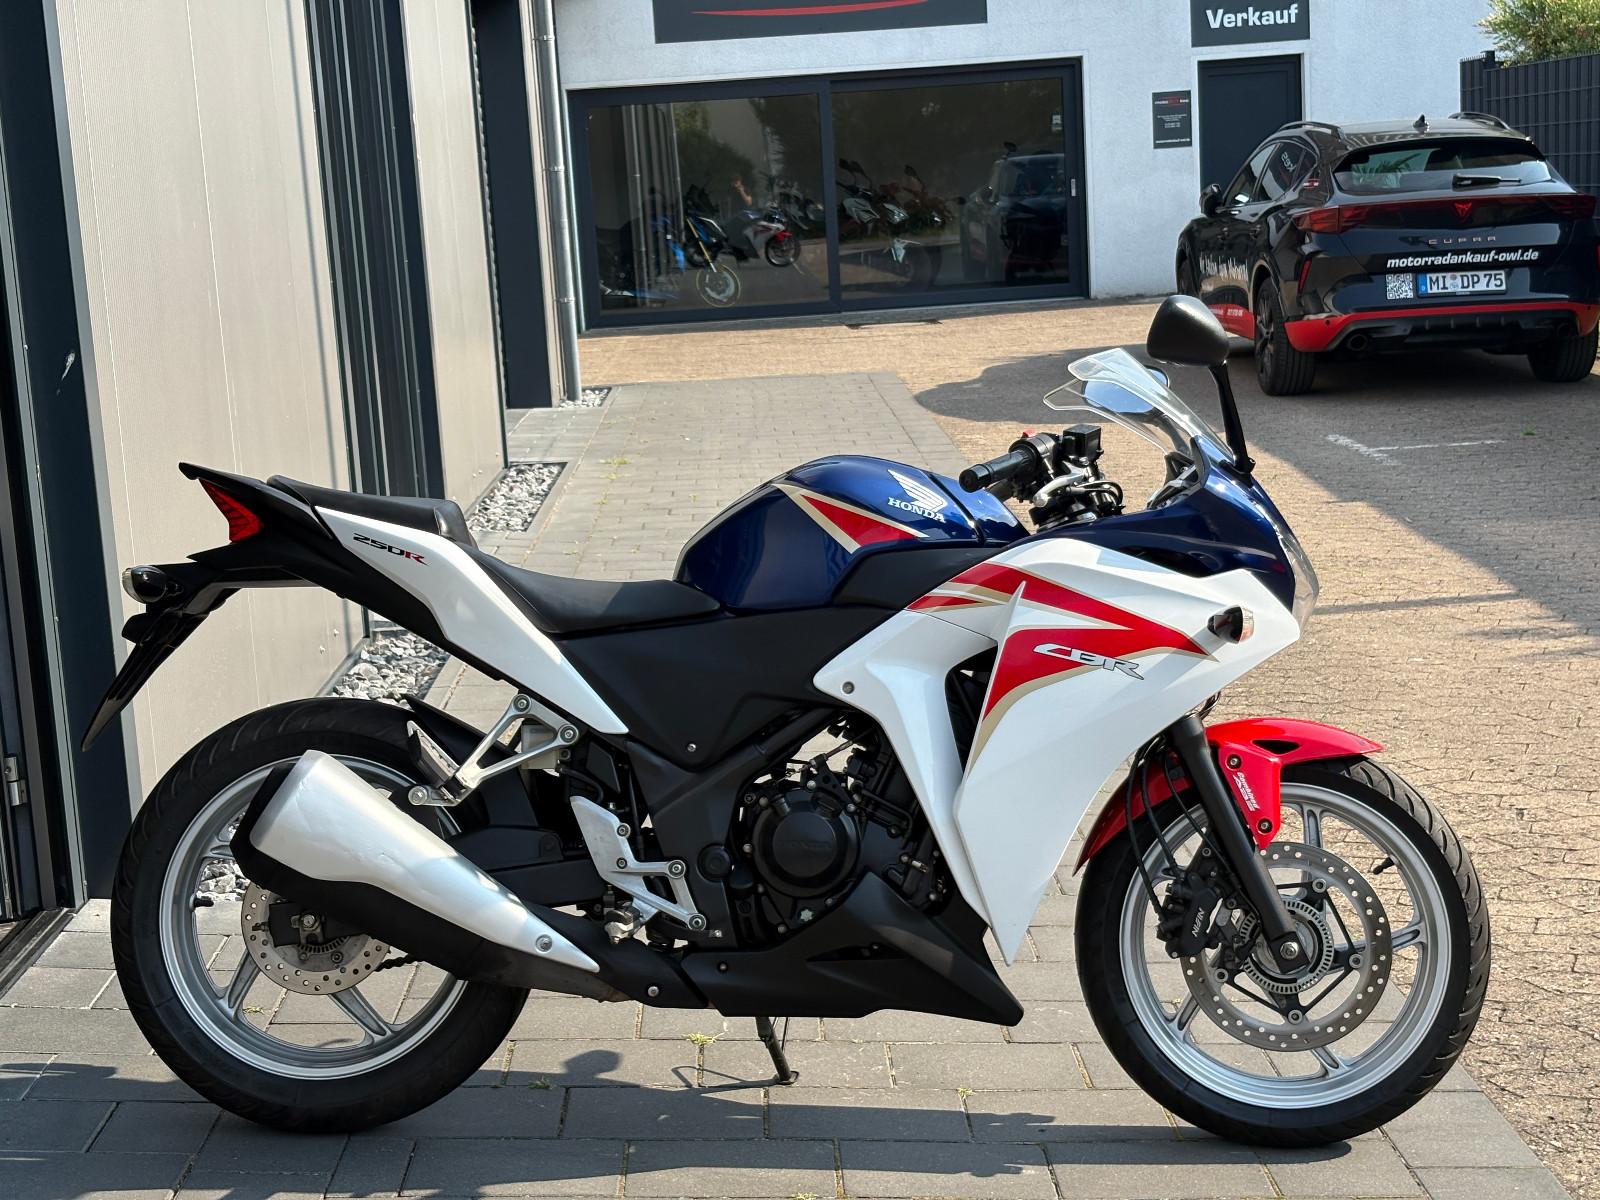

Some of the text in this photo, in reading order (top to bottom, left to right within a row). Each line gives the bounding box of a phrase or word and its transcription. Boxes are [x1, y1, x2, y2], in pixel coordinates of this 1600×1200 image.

[1206, 3, 1298, 29] Verkauf
[1428, 236, 1496, 245] CUPRA
[1386, 249, 1539, 268] motorradankauf-owl.de
[1428, 272, 1504, 291] MI DP 75
[887, 497, 947, 523] HONDA
[353, 532, 429, 566] 250R
[1032, 643, 1145, 680] CBR
